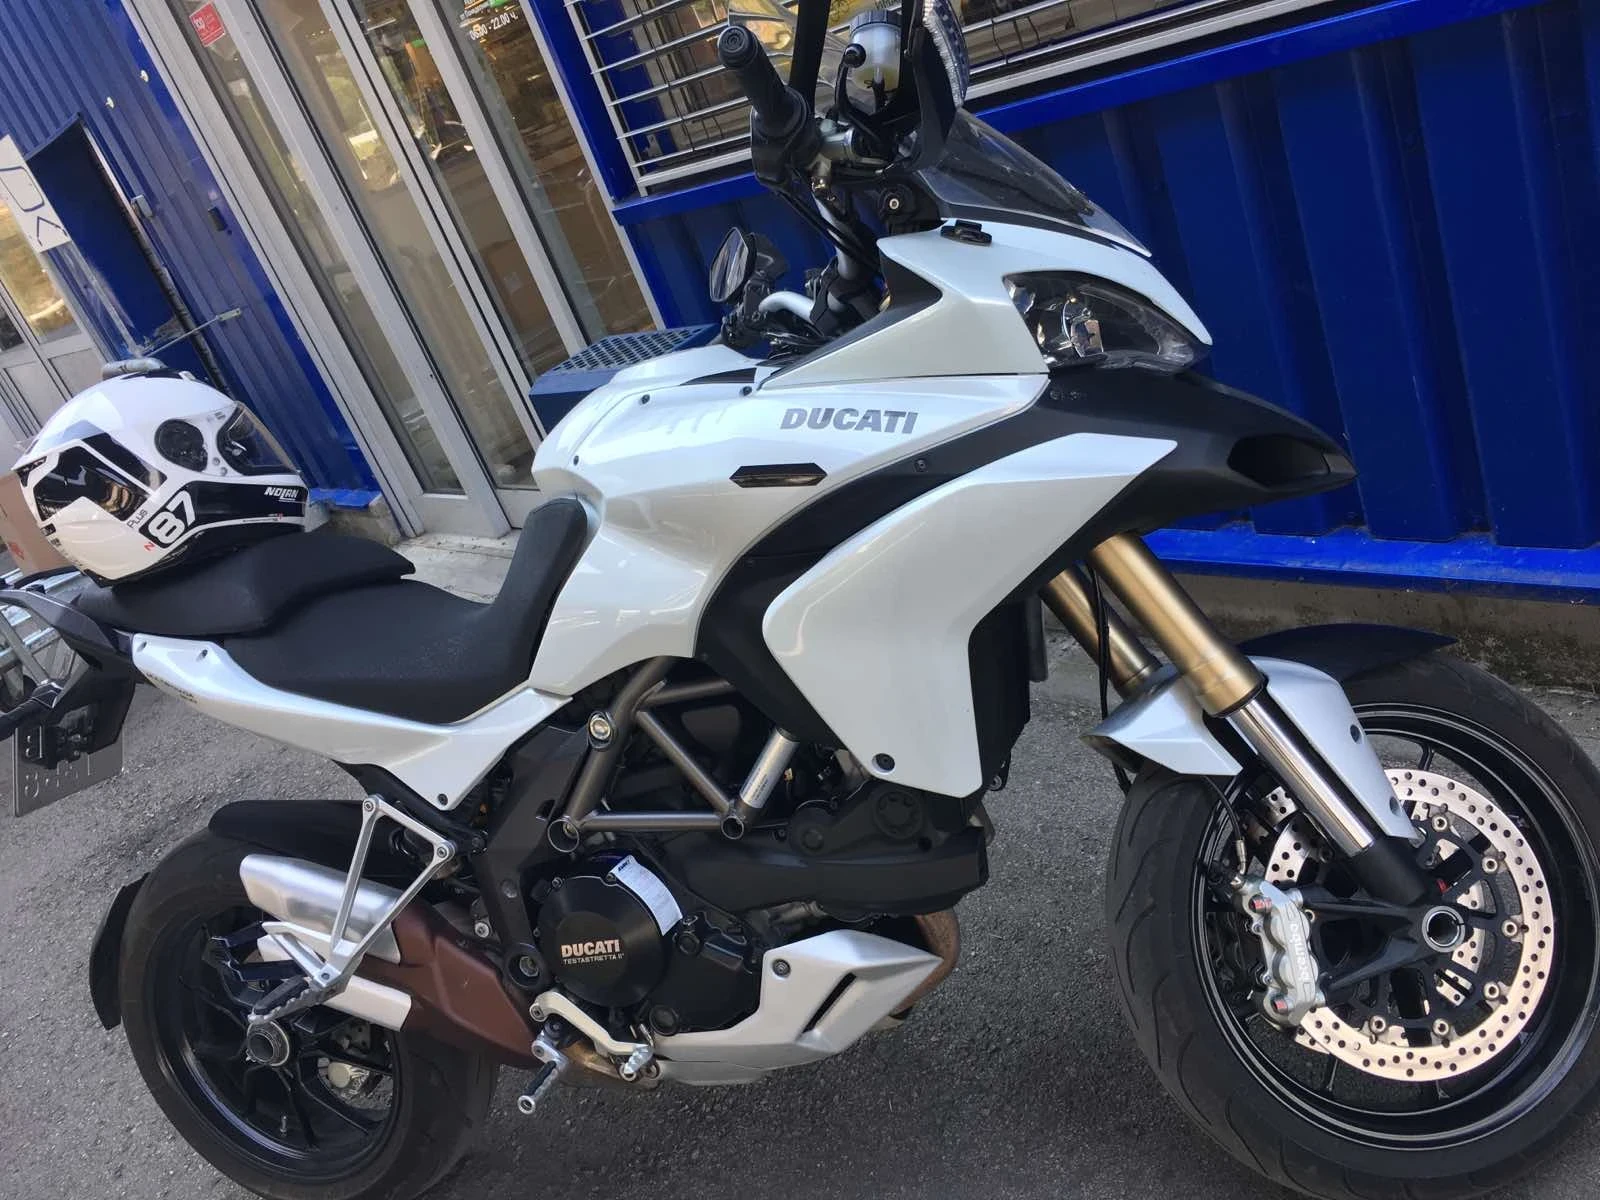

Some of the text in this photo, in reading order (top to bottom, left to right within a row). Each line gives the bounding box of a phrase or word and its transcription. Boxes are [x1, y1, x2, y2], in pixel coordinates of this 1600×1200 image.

[490, 12, 510, 30] 22.00
[780, 407, 919, 434] DUCATI
[264, 486, 299, 499] NOLAN
[148, 490, 195, 544] 87
[561, 939, 620, 958] DUCATI
[563, 954, 617, 965] TESTASTRETTA
